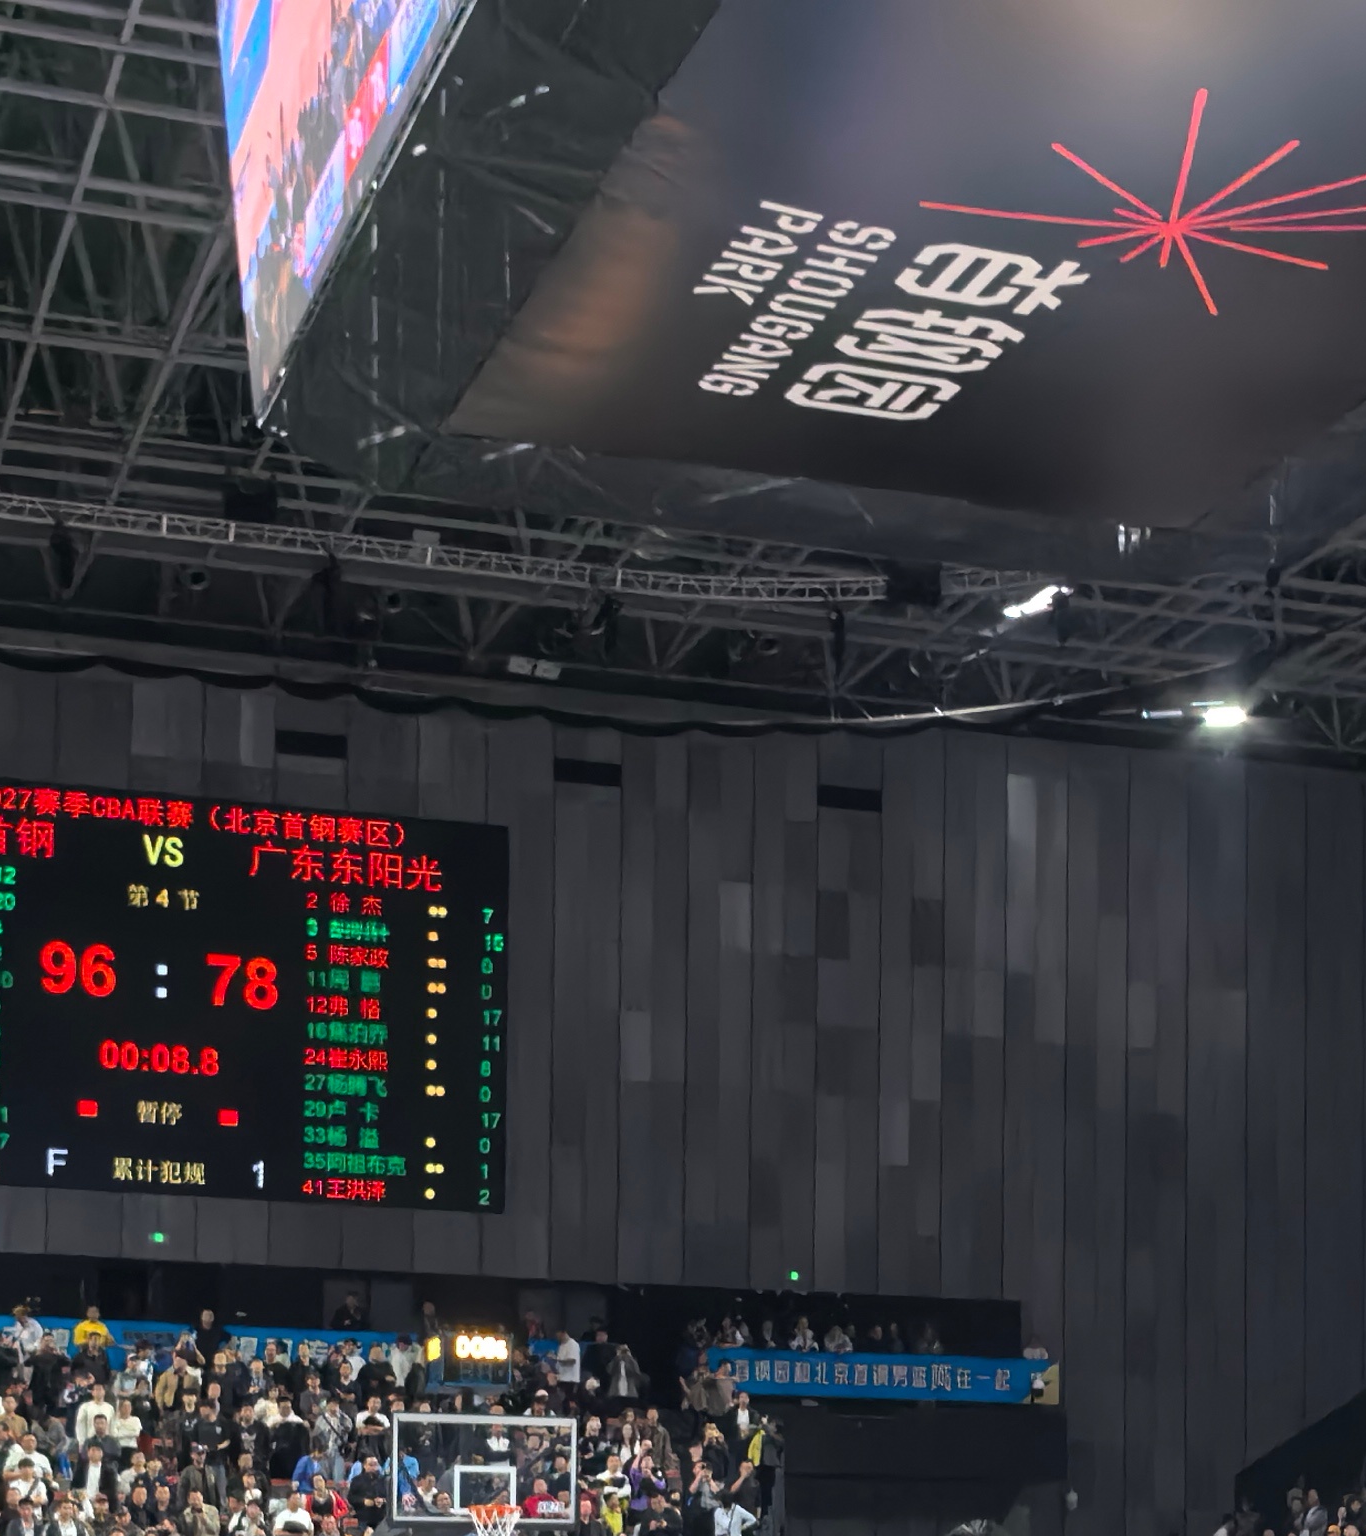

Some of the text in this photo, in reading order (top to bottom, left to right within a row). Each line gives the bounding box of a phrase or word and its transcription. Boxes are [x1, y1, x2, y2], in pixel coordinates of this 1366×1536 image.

[693, 200, 824, 305] PARK
[698, 220, 896, 397] SHOUGANG
[784, 243, 1090, 420] 首钢园
[142, 834, 184, 867] VS
[249, 840, 442, 892] 广东东阳光
[306, 892, 318, 909] 2
[482, 908, 494, 924] 7
[305, 944, 318, 961] 5
[40, 939, 117, 997] 96
[206, 953, 278, 1010] 78
[308, 970, 326, 987] 11
[306, 995, 327, 1014] 12
[484, 1009, 502, 1026] 17
[483, 1035, 500, 1052] 11
[304, 1048, 326, 1066] 24
[304, 1074, 326, 1091] 27
[479, 1086, 491, 1102] 0
[137, 1100, 183, 1126] 暂停
[481, 1113, 501, 1129] 17
[303, 1126, 326, 1144] 33
[479, 1138, 490, 1154] 0
[46, 1147, 265, 1189] F 累计犯规 1
[303, 1152, 325, 1170] 35
[480, 1164, 488, 1180] 1
[301, 1178, 323, 1195] 41
[479, 1190, 490, 1206] 2
